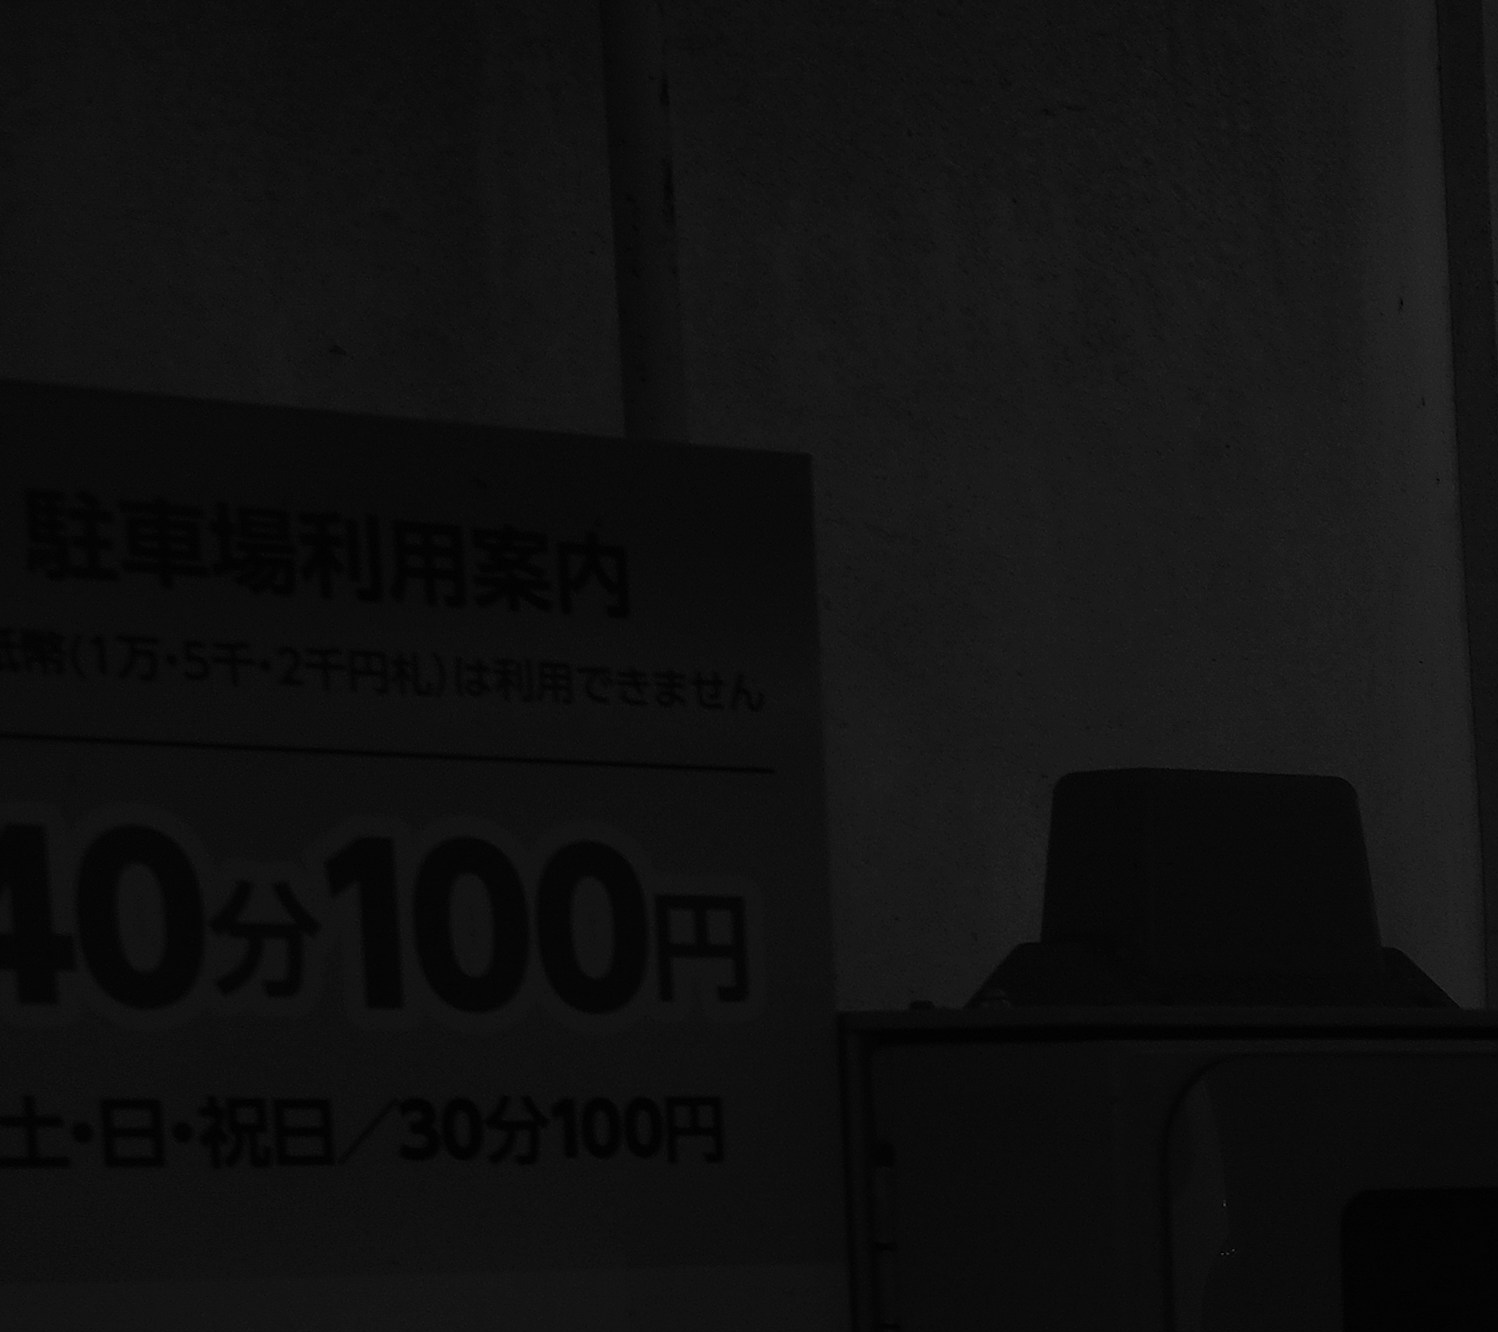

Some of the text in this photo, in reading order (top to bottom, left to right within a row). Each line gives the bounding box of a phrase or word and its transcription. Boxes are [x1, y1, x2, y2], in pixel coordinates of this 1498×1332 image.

[22, 486, 632, 619] 駐車場利用案内
[0, 822, 752, 1015] 40分100円
